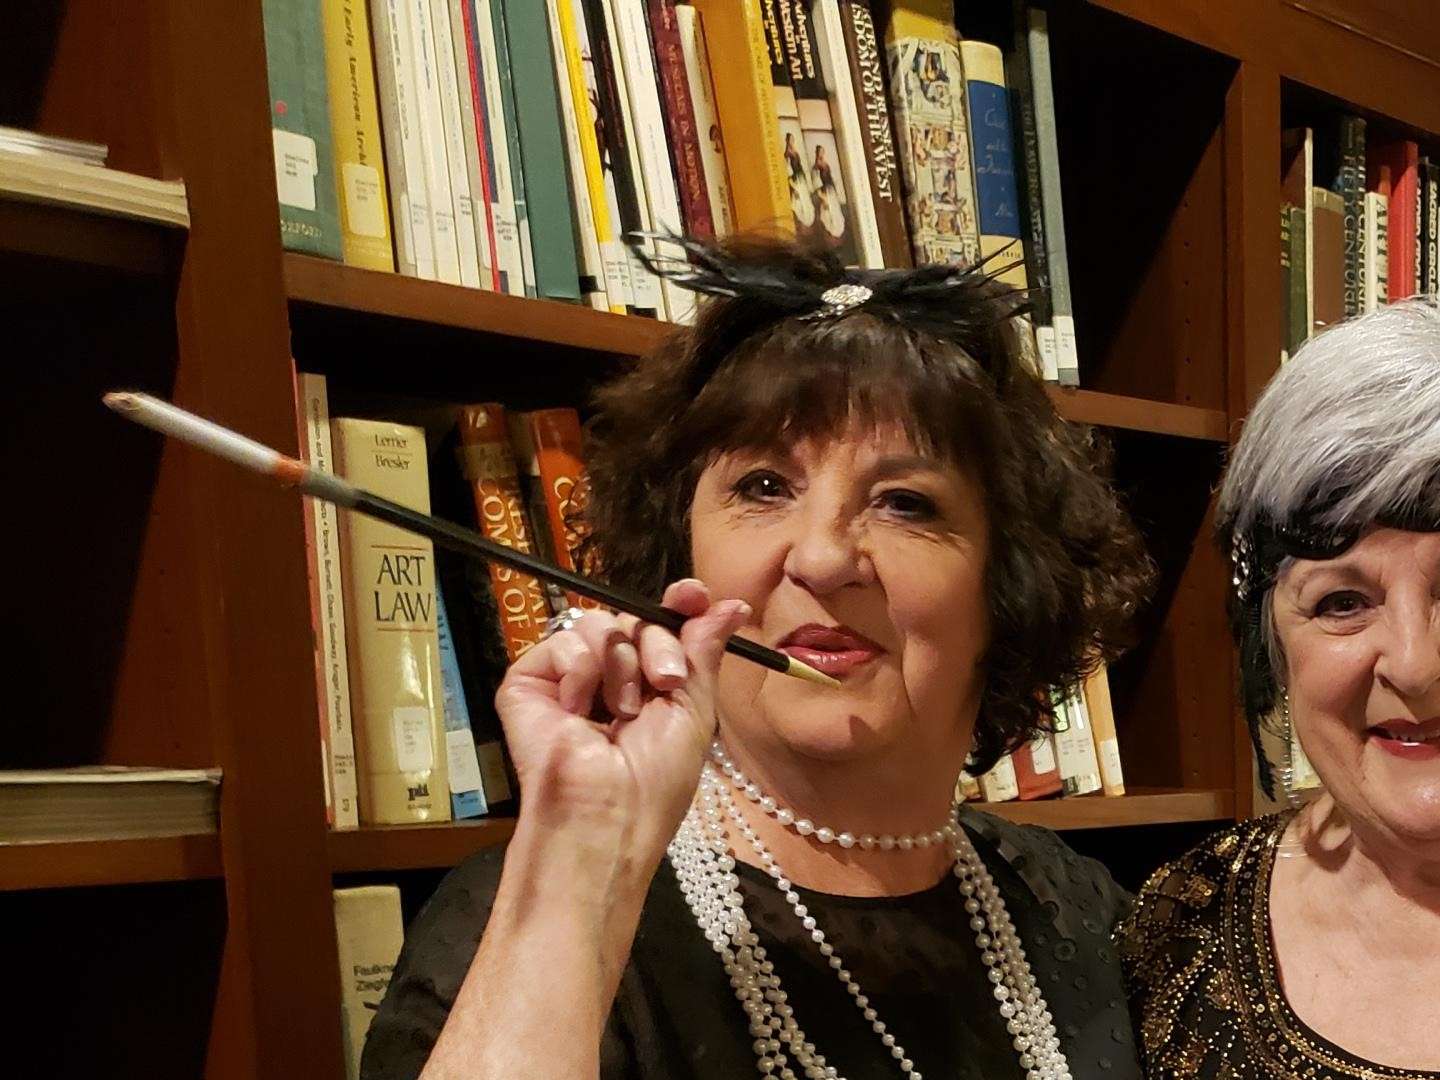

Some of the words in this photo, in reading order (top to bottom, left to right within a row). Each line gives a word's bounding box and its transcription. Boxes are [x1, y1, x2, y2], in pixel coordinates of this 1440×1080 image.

[344, 7, 355, 46] Early
[851, 3, 871, 67] ISDOM
[348, 55, 363, 122] American
[667, 44, 688, 115] MUSEUMS
[790, 57, 804, 80] Art
[862, 71, 876, 96] OF
[679, 120, 691, 136] IN
[866, 100, 883, 143] THE
[875, 95, 896, 175] RUSSELL
[682, 142, 702, 202] MOTION
[873, 146, 893, 202] WEST
[1429, 180, 1438, 238] SACRED
[1343, 215, 1356, 318] CENTURIE
[377, 554, 426, 586] ART
[374, 590, 432, 622] LAW
[502, 588, 531, 628] OF
